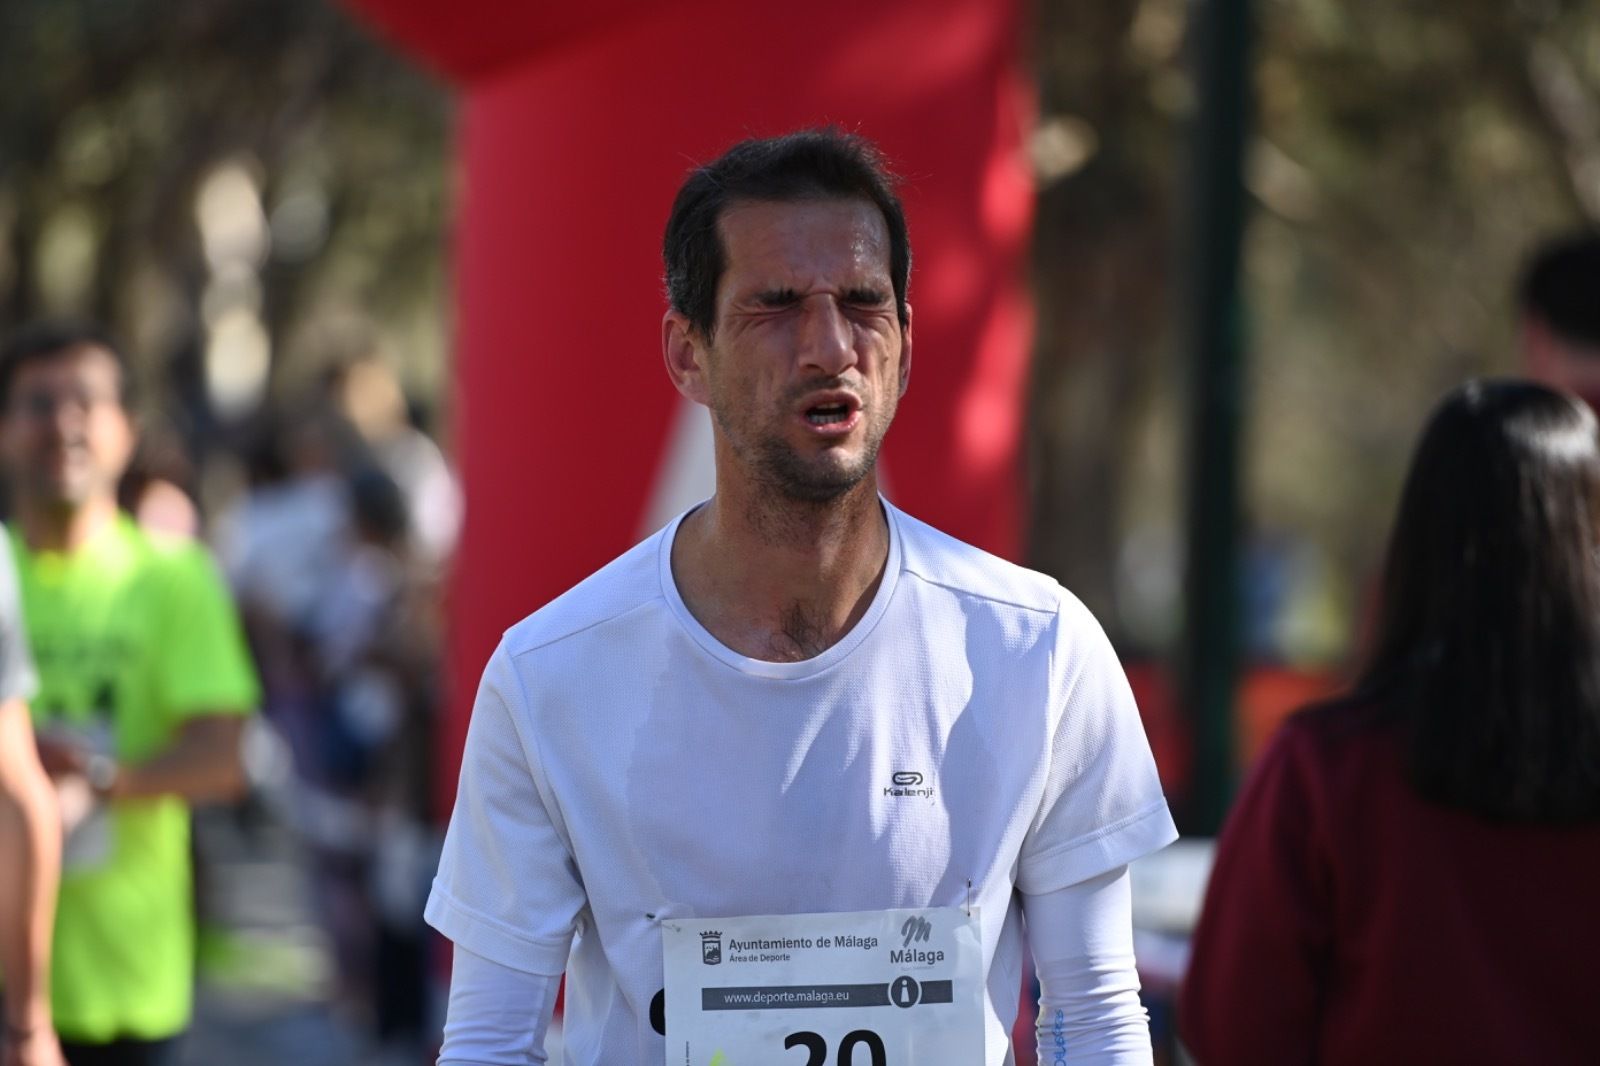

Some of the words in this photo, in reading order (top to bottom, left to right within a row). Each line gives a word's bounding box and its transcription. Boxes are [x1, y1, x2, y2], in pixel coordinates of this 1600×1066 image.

[729, 937, 812, 953] Ayuntamiento
[815, 936, 832, 949] de
[834, 935, 879, 950] Málaga
[749, 953, 759, 962] de
[760, 953, 791, 964] Deporte
[890, 948, 945, 965] Málaga
[723, 989, 851, 1005] www.deporte.malaga.eu
